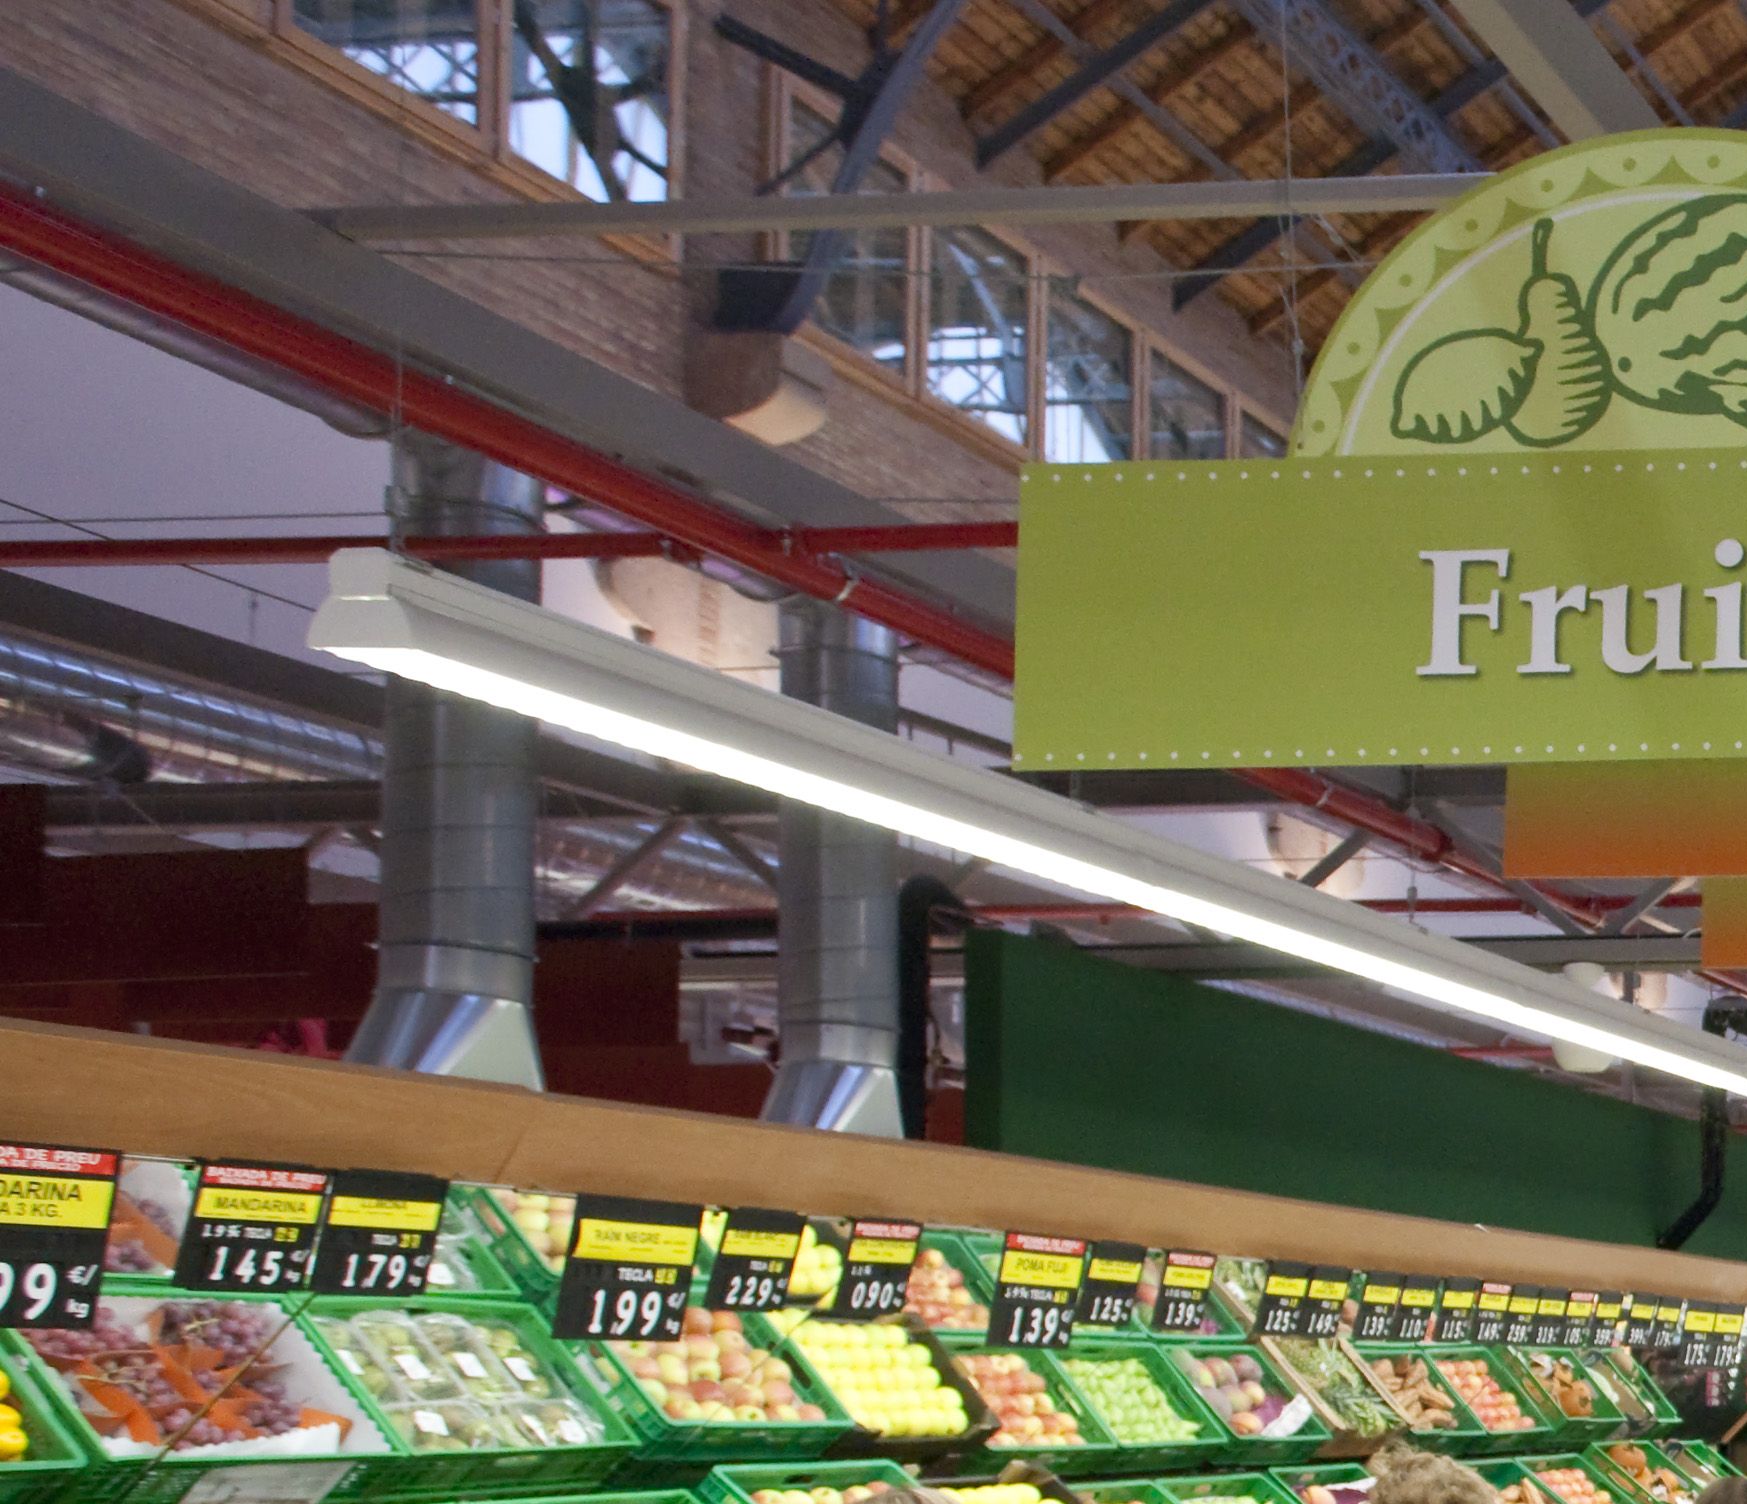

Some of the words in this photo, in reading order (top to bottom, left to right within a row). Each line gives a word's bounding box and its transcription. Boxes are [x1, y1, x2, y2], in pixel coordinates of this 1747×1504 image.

[25, 1148, 49, 1160] DE
[53, 1150, 100, 1165] PREU
[15, 1203, 26, 1216] 3
[214, 1197, 306, 1213] MANDARINA
[65, 1298, 90, 1319] kg
